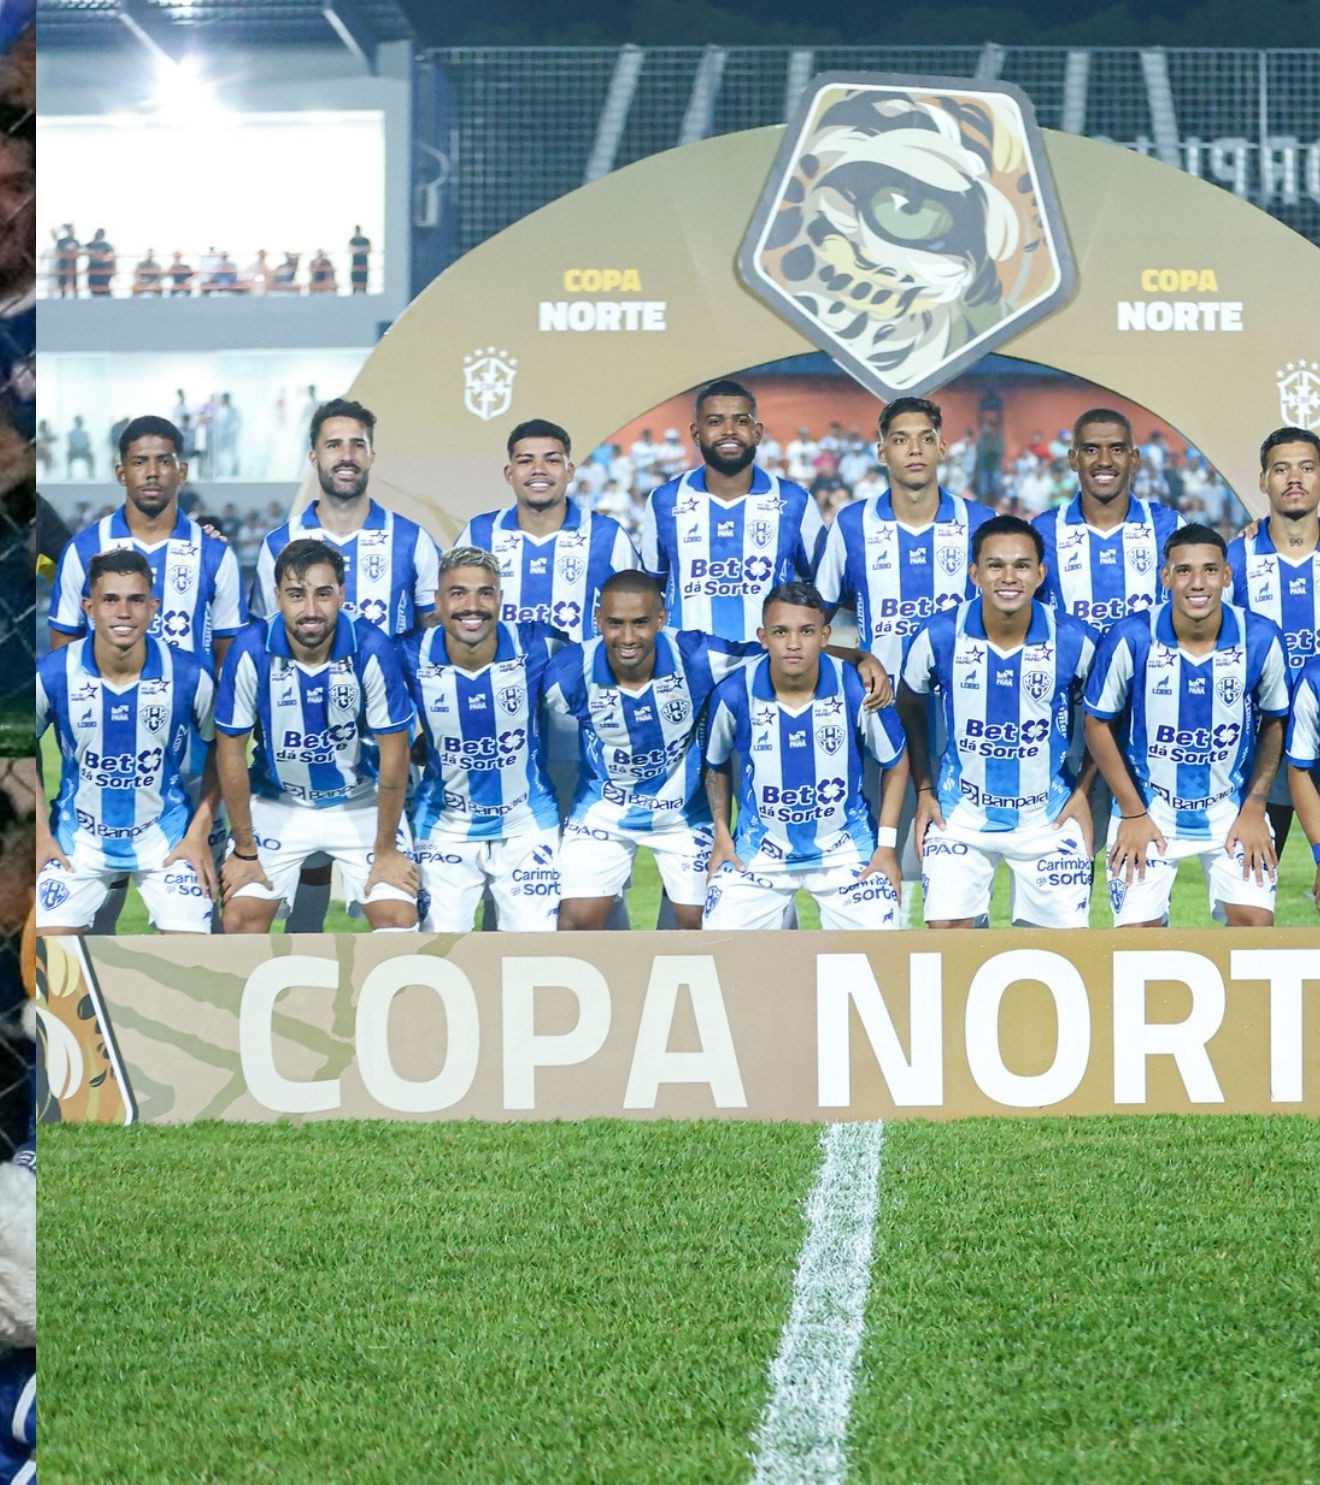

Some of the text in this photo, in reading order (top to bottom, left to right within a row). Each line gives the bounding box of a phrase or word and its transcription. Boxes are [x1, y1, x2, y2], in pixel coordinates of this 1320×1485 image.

[562, 268, 642, 292] COPA
[1140, 268, 1219, 293] COPA
[538, 300, 667, 332] NORTE
[1116, 300, 1245, 332] NORTE
[690, 558, 741, 580] Bet
[684, 581, 761, 596] dá Sorte
[502, 603, 550, 623] Bet
[881, 598, 932, 619] Bet
[1072, 598, 1123, 619] Bet
[874, 620, 893, 634] dá
[1284, 629, 1313, 650] et
[283, 729, 330, 750] Bet
[965, 718, 1019, 742] Bet
[1155, 724, 1209, 748] Bet
[443, 735, 496, 757] Bet
[959, 737, 1040, 760] dá Sorte
[1148, 744, 1229, 764] dá Sorte
[84, 750, 135, 773] Bet
[459, 754, 518, 771] Sorte
[612, 748, 667, 768] Bet
[94, 773, 155, 789] Sorte
[761, 784, 814, 805] Bet
[758, 804, 836, 823] dá Sorte
[523, 881, 561, 896] sort
[237, 953, 748, 1113] COPA
